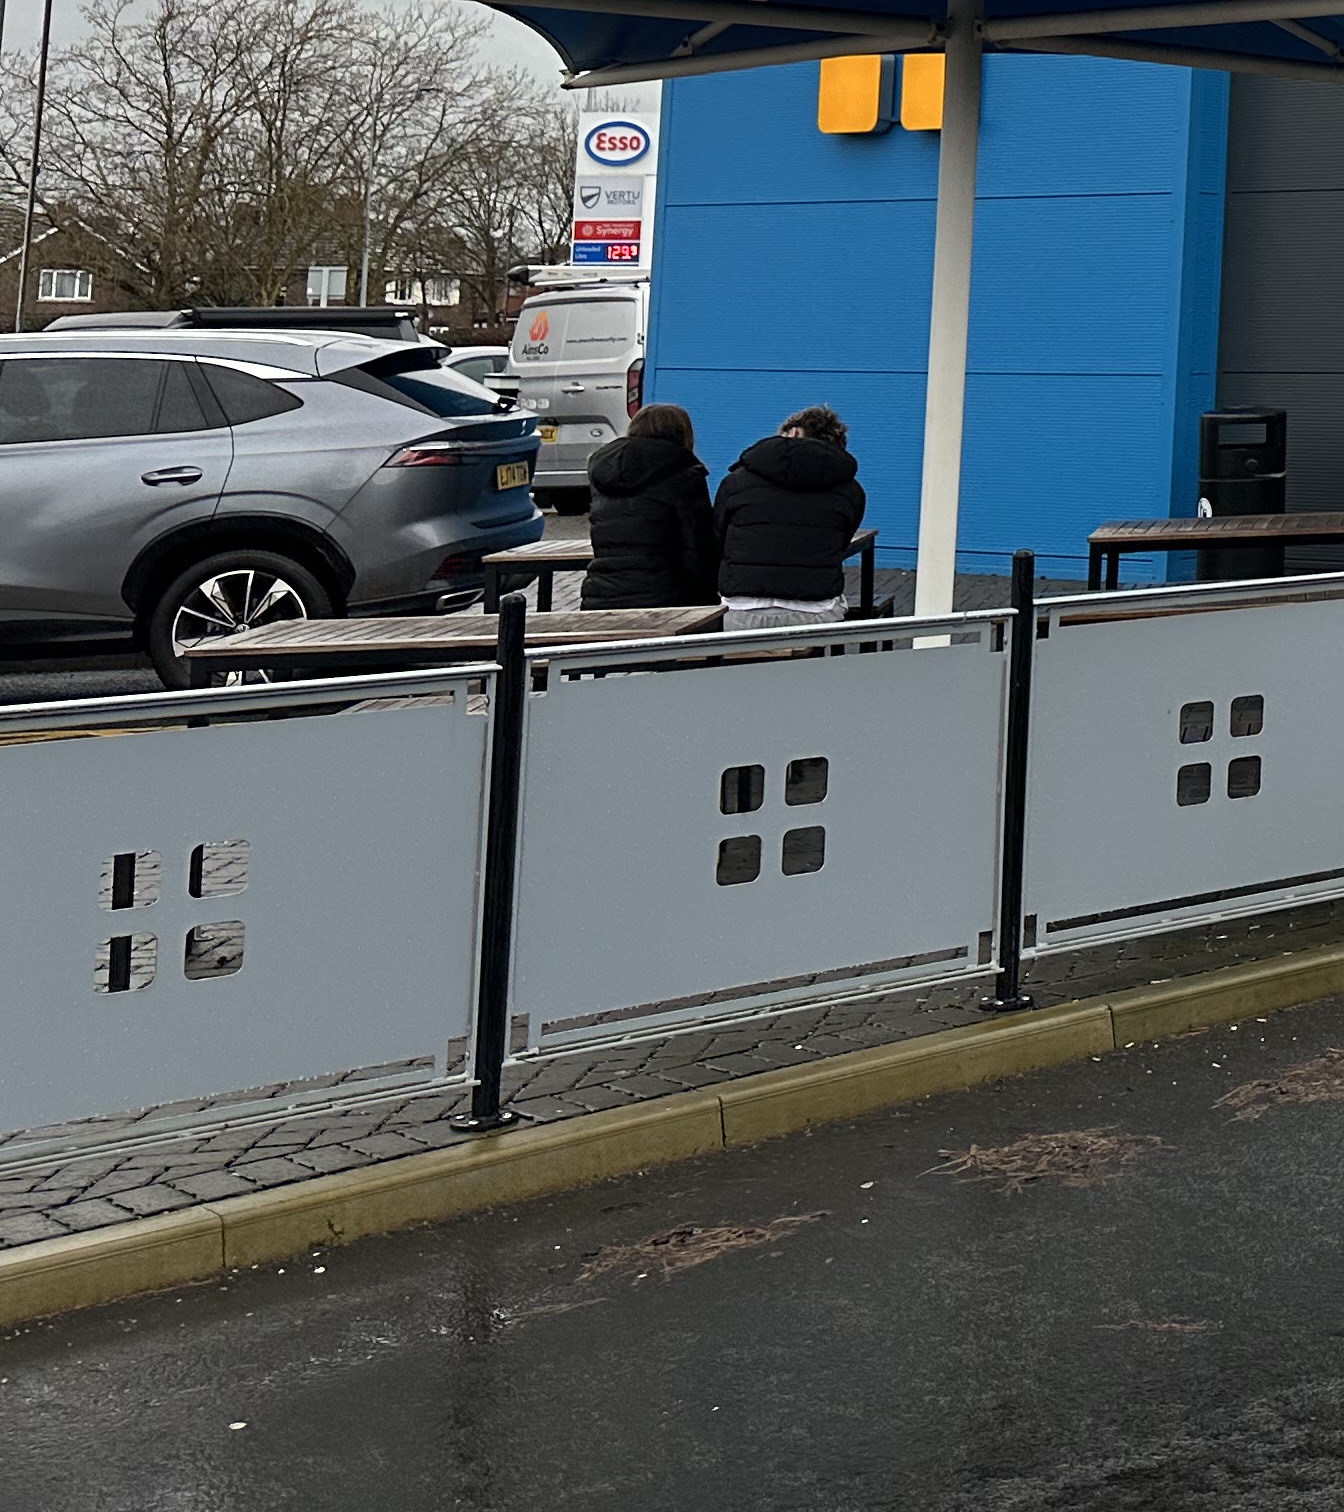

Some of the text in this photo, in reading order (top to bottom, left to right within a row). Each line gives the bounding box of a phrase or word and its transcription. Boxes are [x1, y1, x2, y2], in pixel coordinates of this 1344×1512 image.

[595, 132, 641, 151] Esso
[605, 190, 640, 200] VERTU
[596, 225, 634, 237] Synergy
